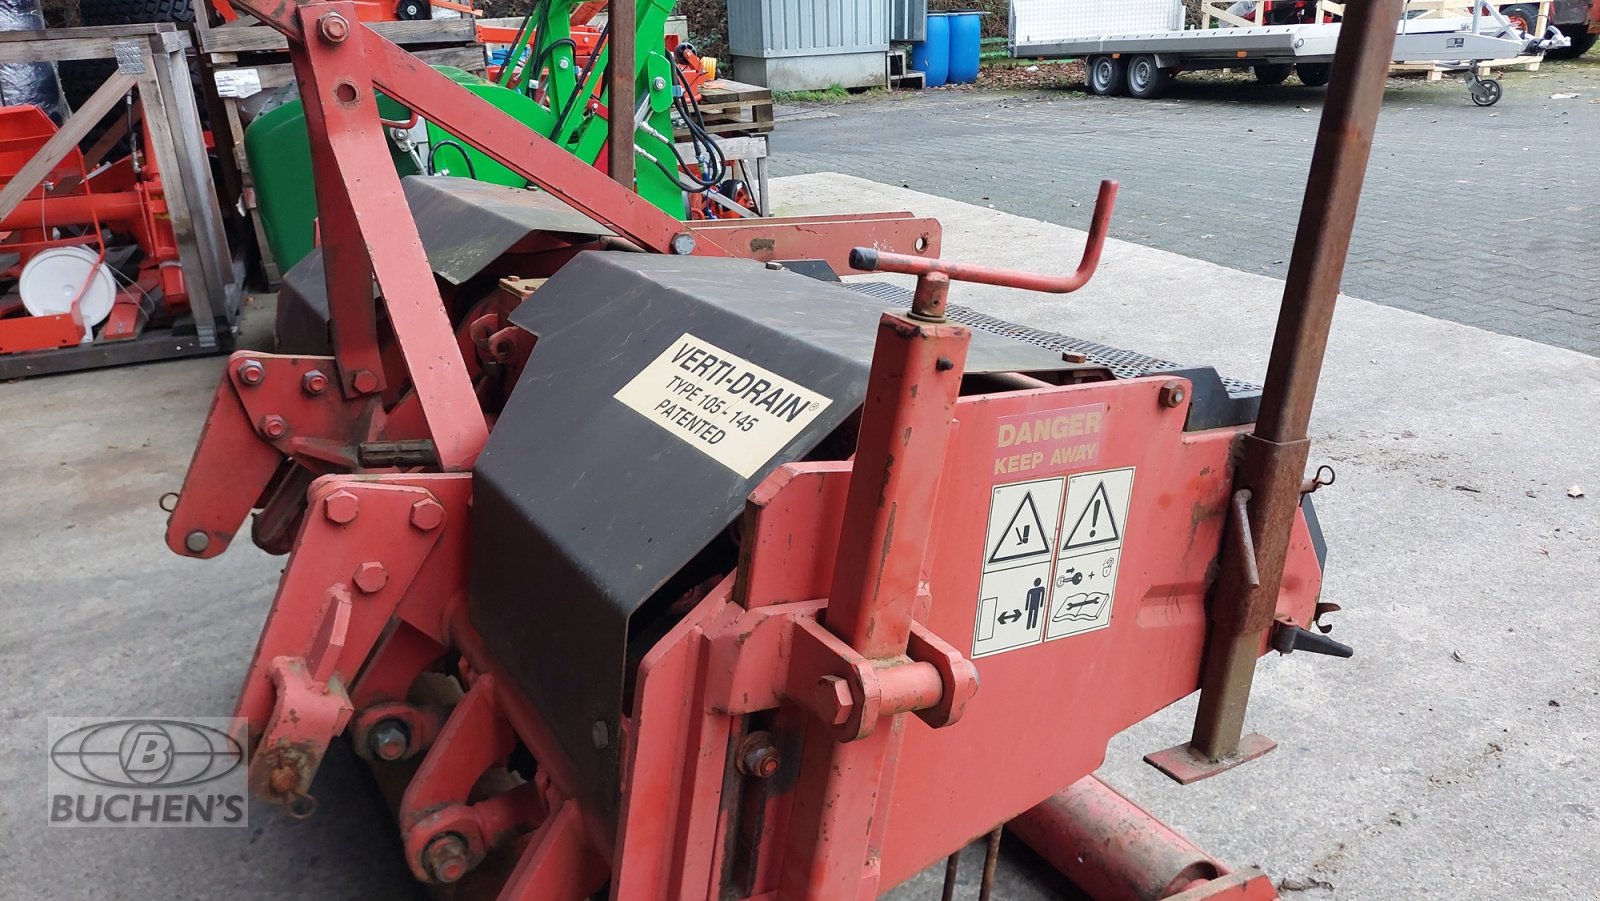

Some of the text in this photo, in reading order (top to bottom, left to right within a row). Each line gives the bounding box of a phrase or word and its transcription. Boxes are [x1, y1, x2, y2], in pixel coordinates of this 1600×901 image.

[654, 398, 726, 445] PATENTED
[666, 375, 703, 402] TYPE
[698, 394, 726, 414] 105
[729, 411, 759, 432] 145
[997, 411, 1101, 448] DANGER
[994, 442, 1099, 475] KEEP AWAY
